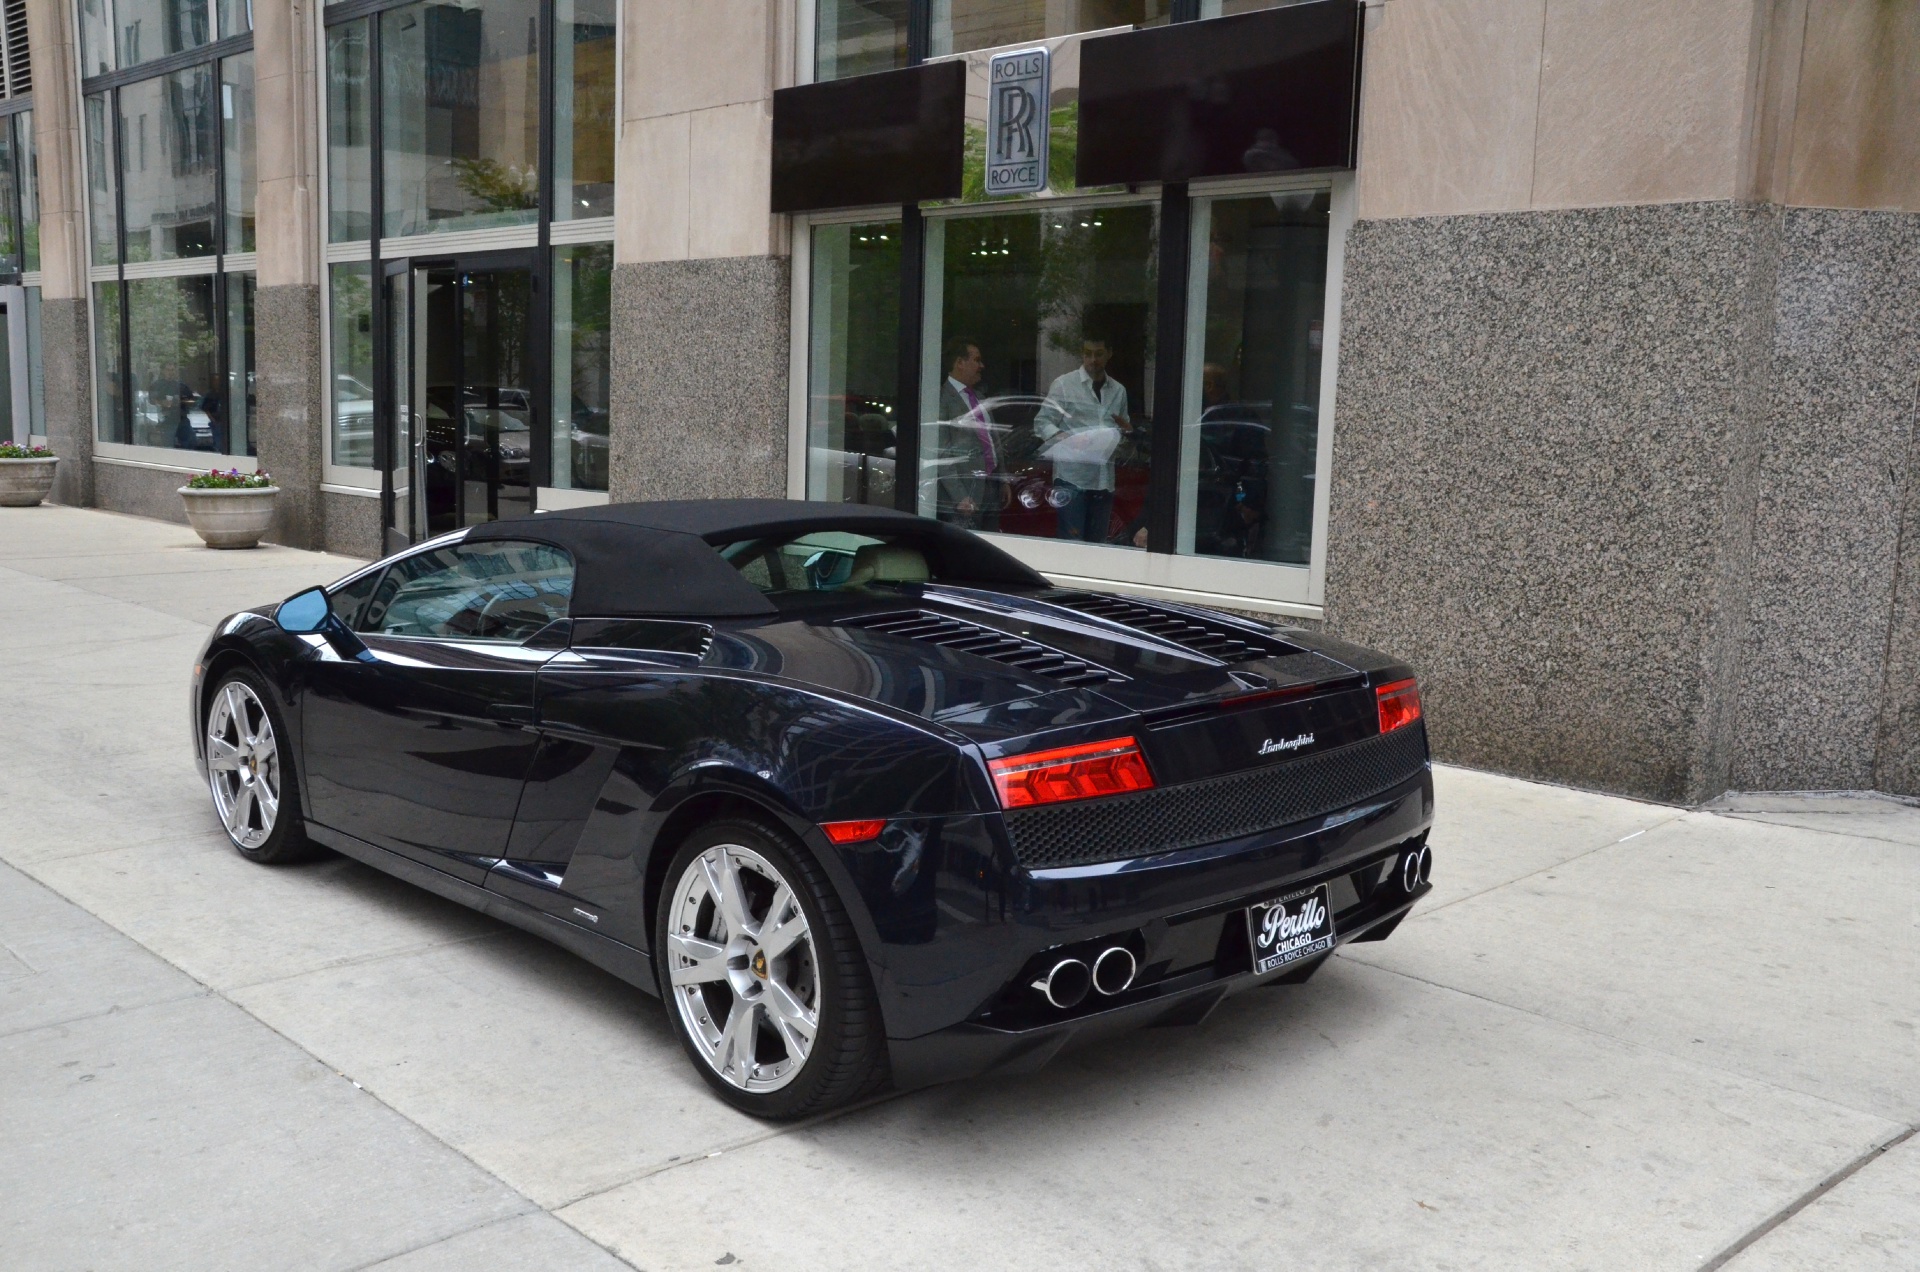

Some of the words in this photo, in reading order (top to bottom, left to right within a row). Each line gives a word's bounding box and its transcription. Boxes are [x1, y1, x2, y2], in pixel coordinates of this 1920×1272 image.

[995, 57, 1040, 79] ROLLS
[991, 166, 1036, 186] ROYCE
[1257, 732, 1315, 755] Lamborghini
[1257, 896, 1326, 949] Perillo
[1267, 955, 1284, 969] ROLLS
[1284, 948, 1303, 961] ROYCE
[1302, 940, 1326, 955] CHICAGO
[1276, 932, 1312, 955] CHICAGO
